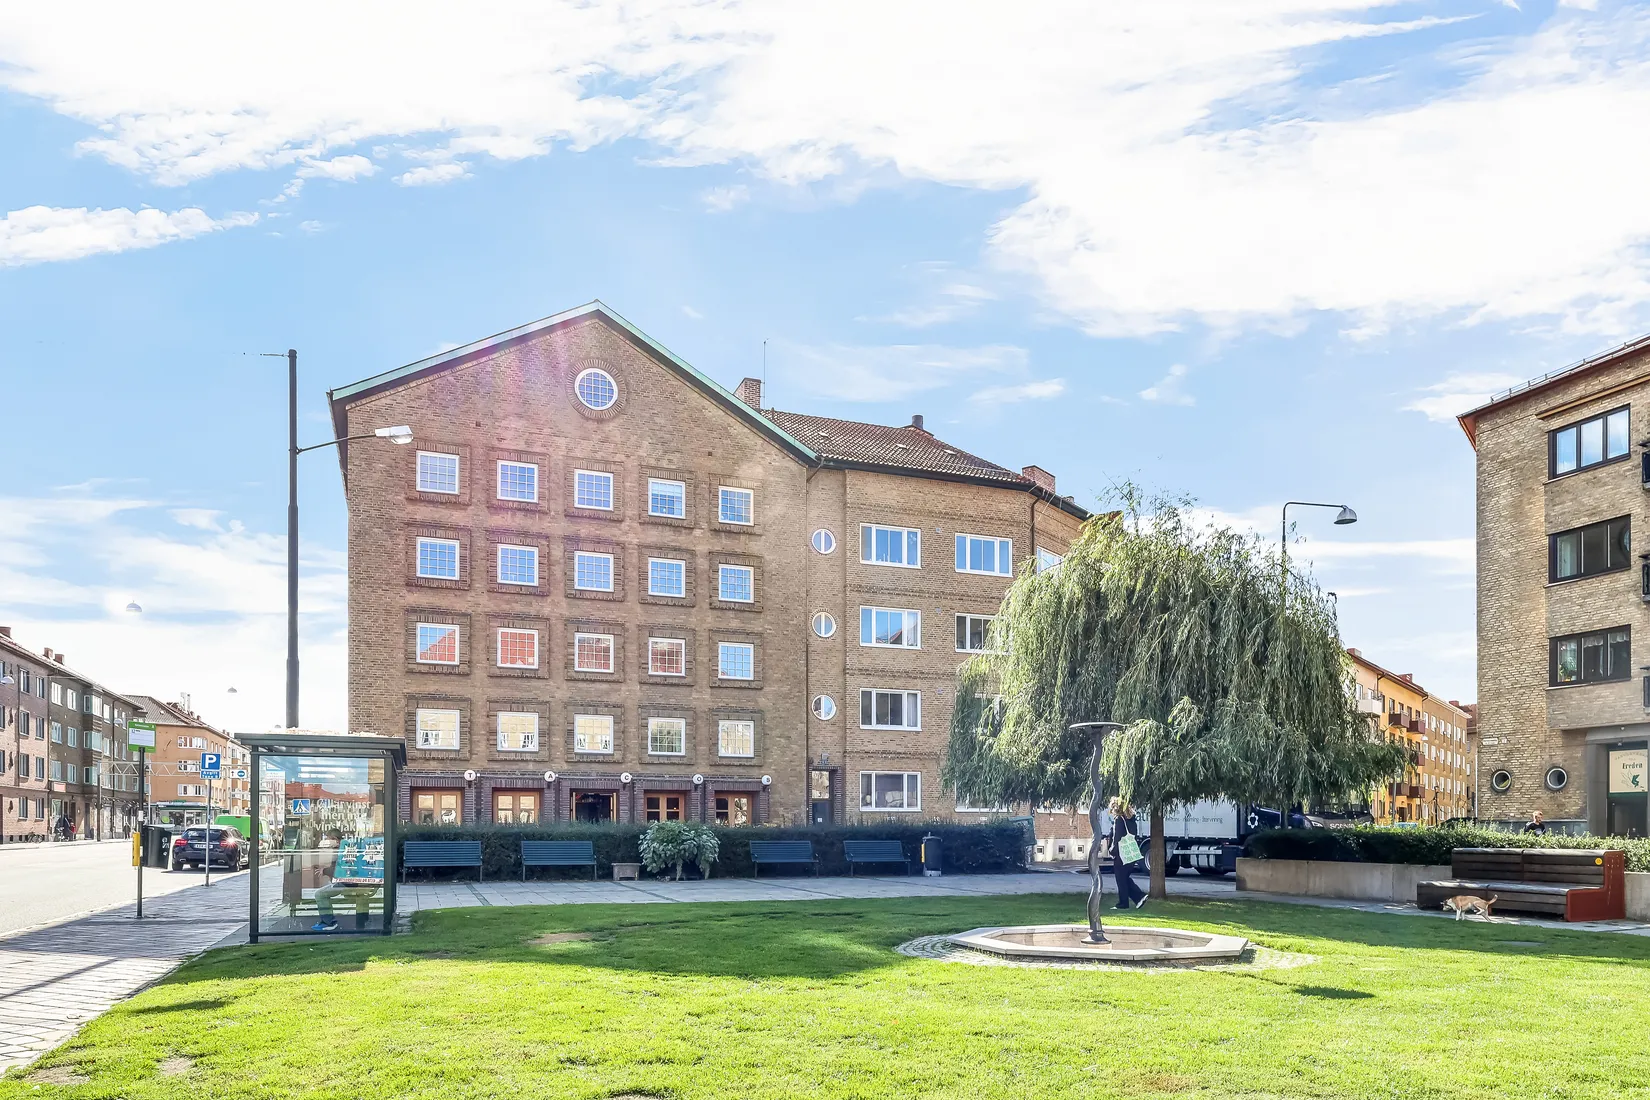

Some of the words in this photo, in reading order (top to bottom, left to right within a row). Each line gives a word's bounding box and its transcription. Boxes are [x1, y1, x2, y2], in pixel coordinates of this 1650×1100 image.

[205, 754, 217, 769] P
[346, 801, 371, 809] vinst
[321, 811, 344, 820] men
